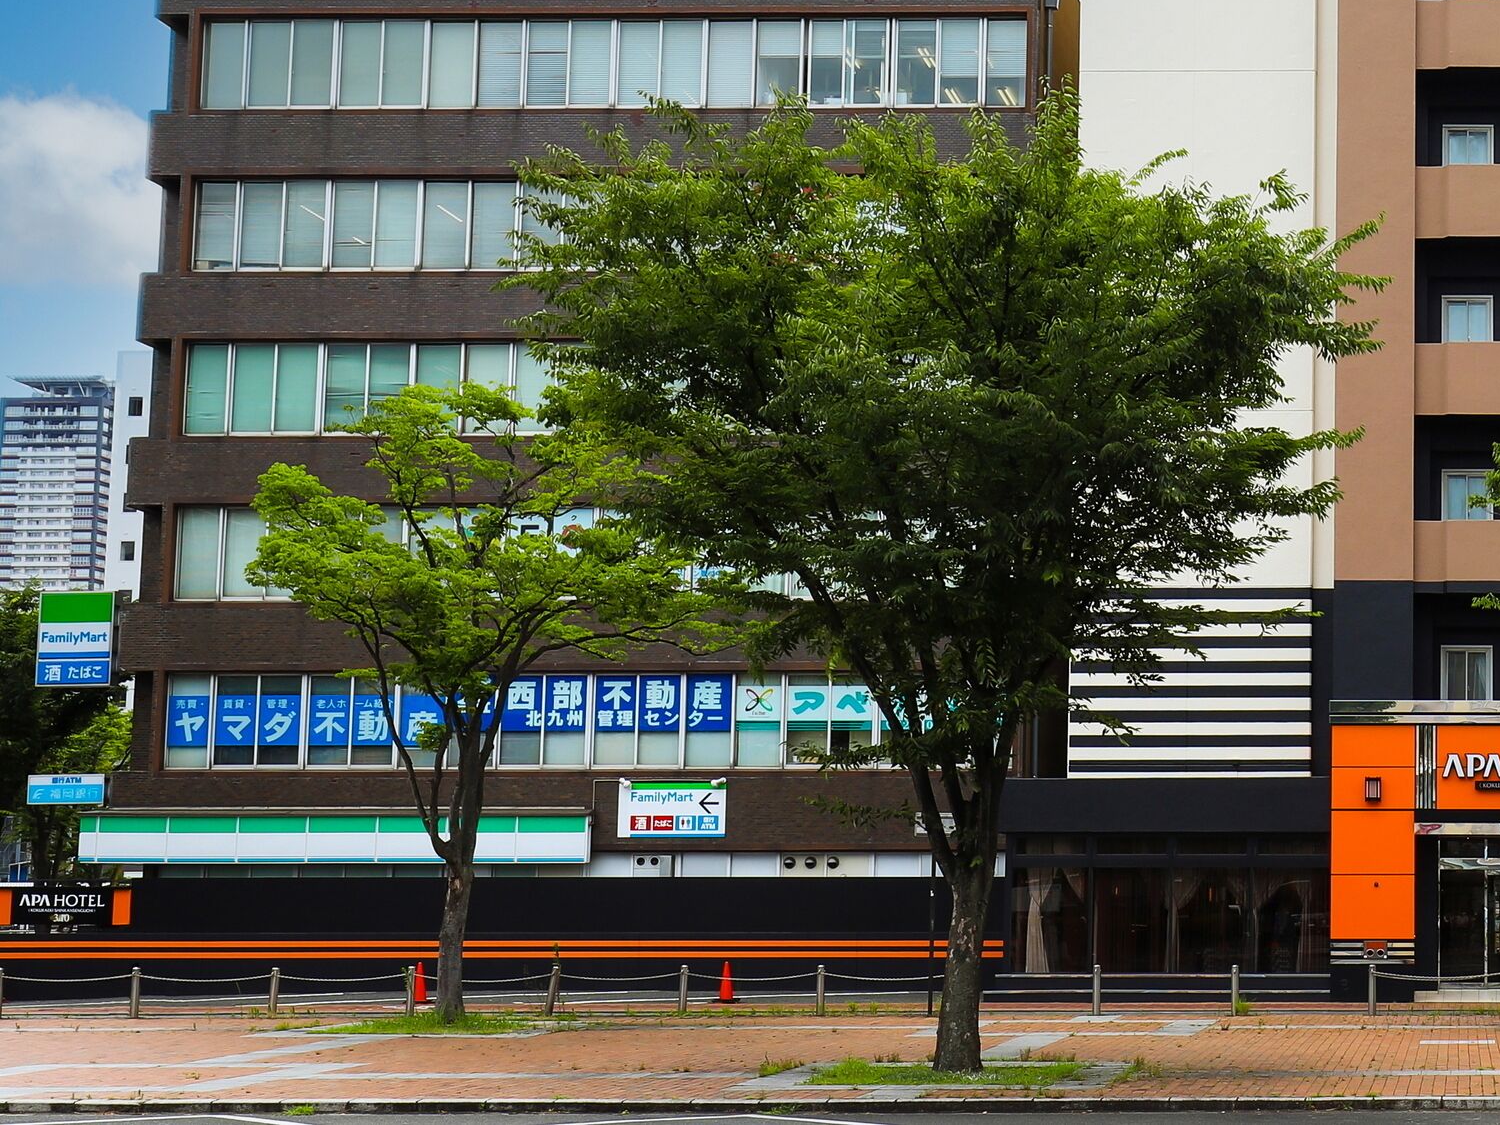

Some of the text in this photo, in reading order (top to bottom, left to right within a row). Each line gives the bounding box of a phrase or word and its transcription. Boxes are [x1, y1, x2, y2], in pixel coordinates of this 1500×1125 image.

[41, 631, 107, 645] FamilyMart
[44, 664, 102, 681] 酒 たばこ
[526, 711, 723, 727] 北九州管理センター
[631, 792, 693, 804] FamilyMart
[634, 817, 647, 829] 酒
[19, 894, 105, 907] APA HOTEL
